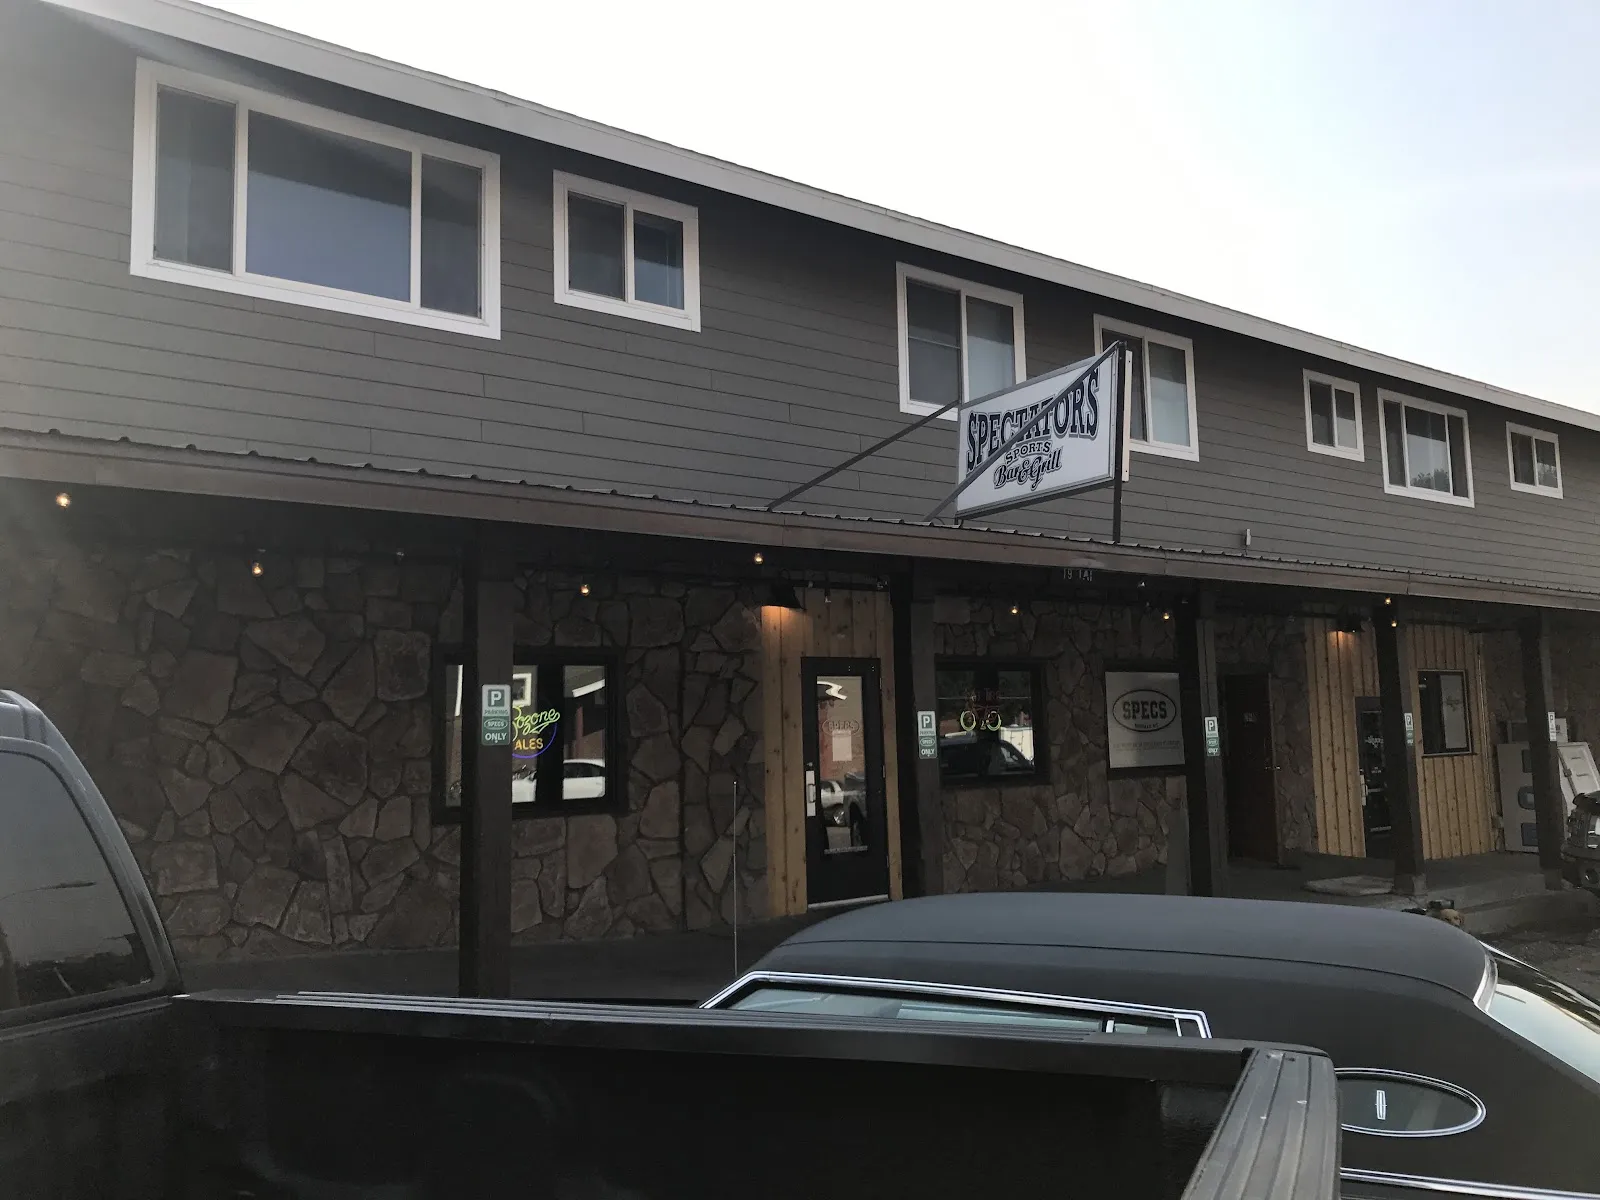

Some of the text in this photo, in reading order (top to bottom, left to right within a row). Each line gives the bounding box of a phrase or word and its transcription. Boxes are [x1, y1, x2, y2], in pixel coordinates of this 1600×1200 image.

[966, 366, 1100, 475] SPECTATORS
[1005, 440, 1052, 465] SPORTS
[490, 690, 502, 706] P
[1122, 700, 1167, 720] SPECS
[922, 715, 931, 728] P
[484, 732, 507, 741] ONLY
[514, 737, 544, 750] ALES
